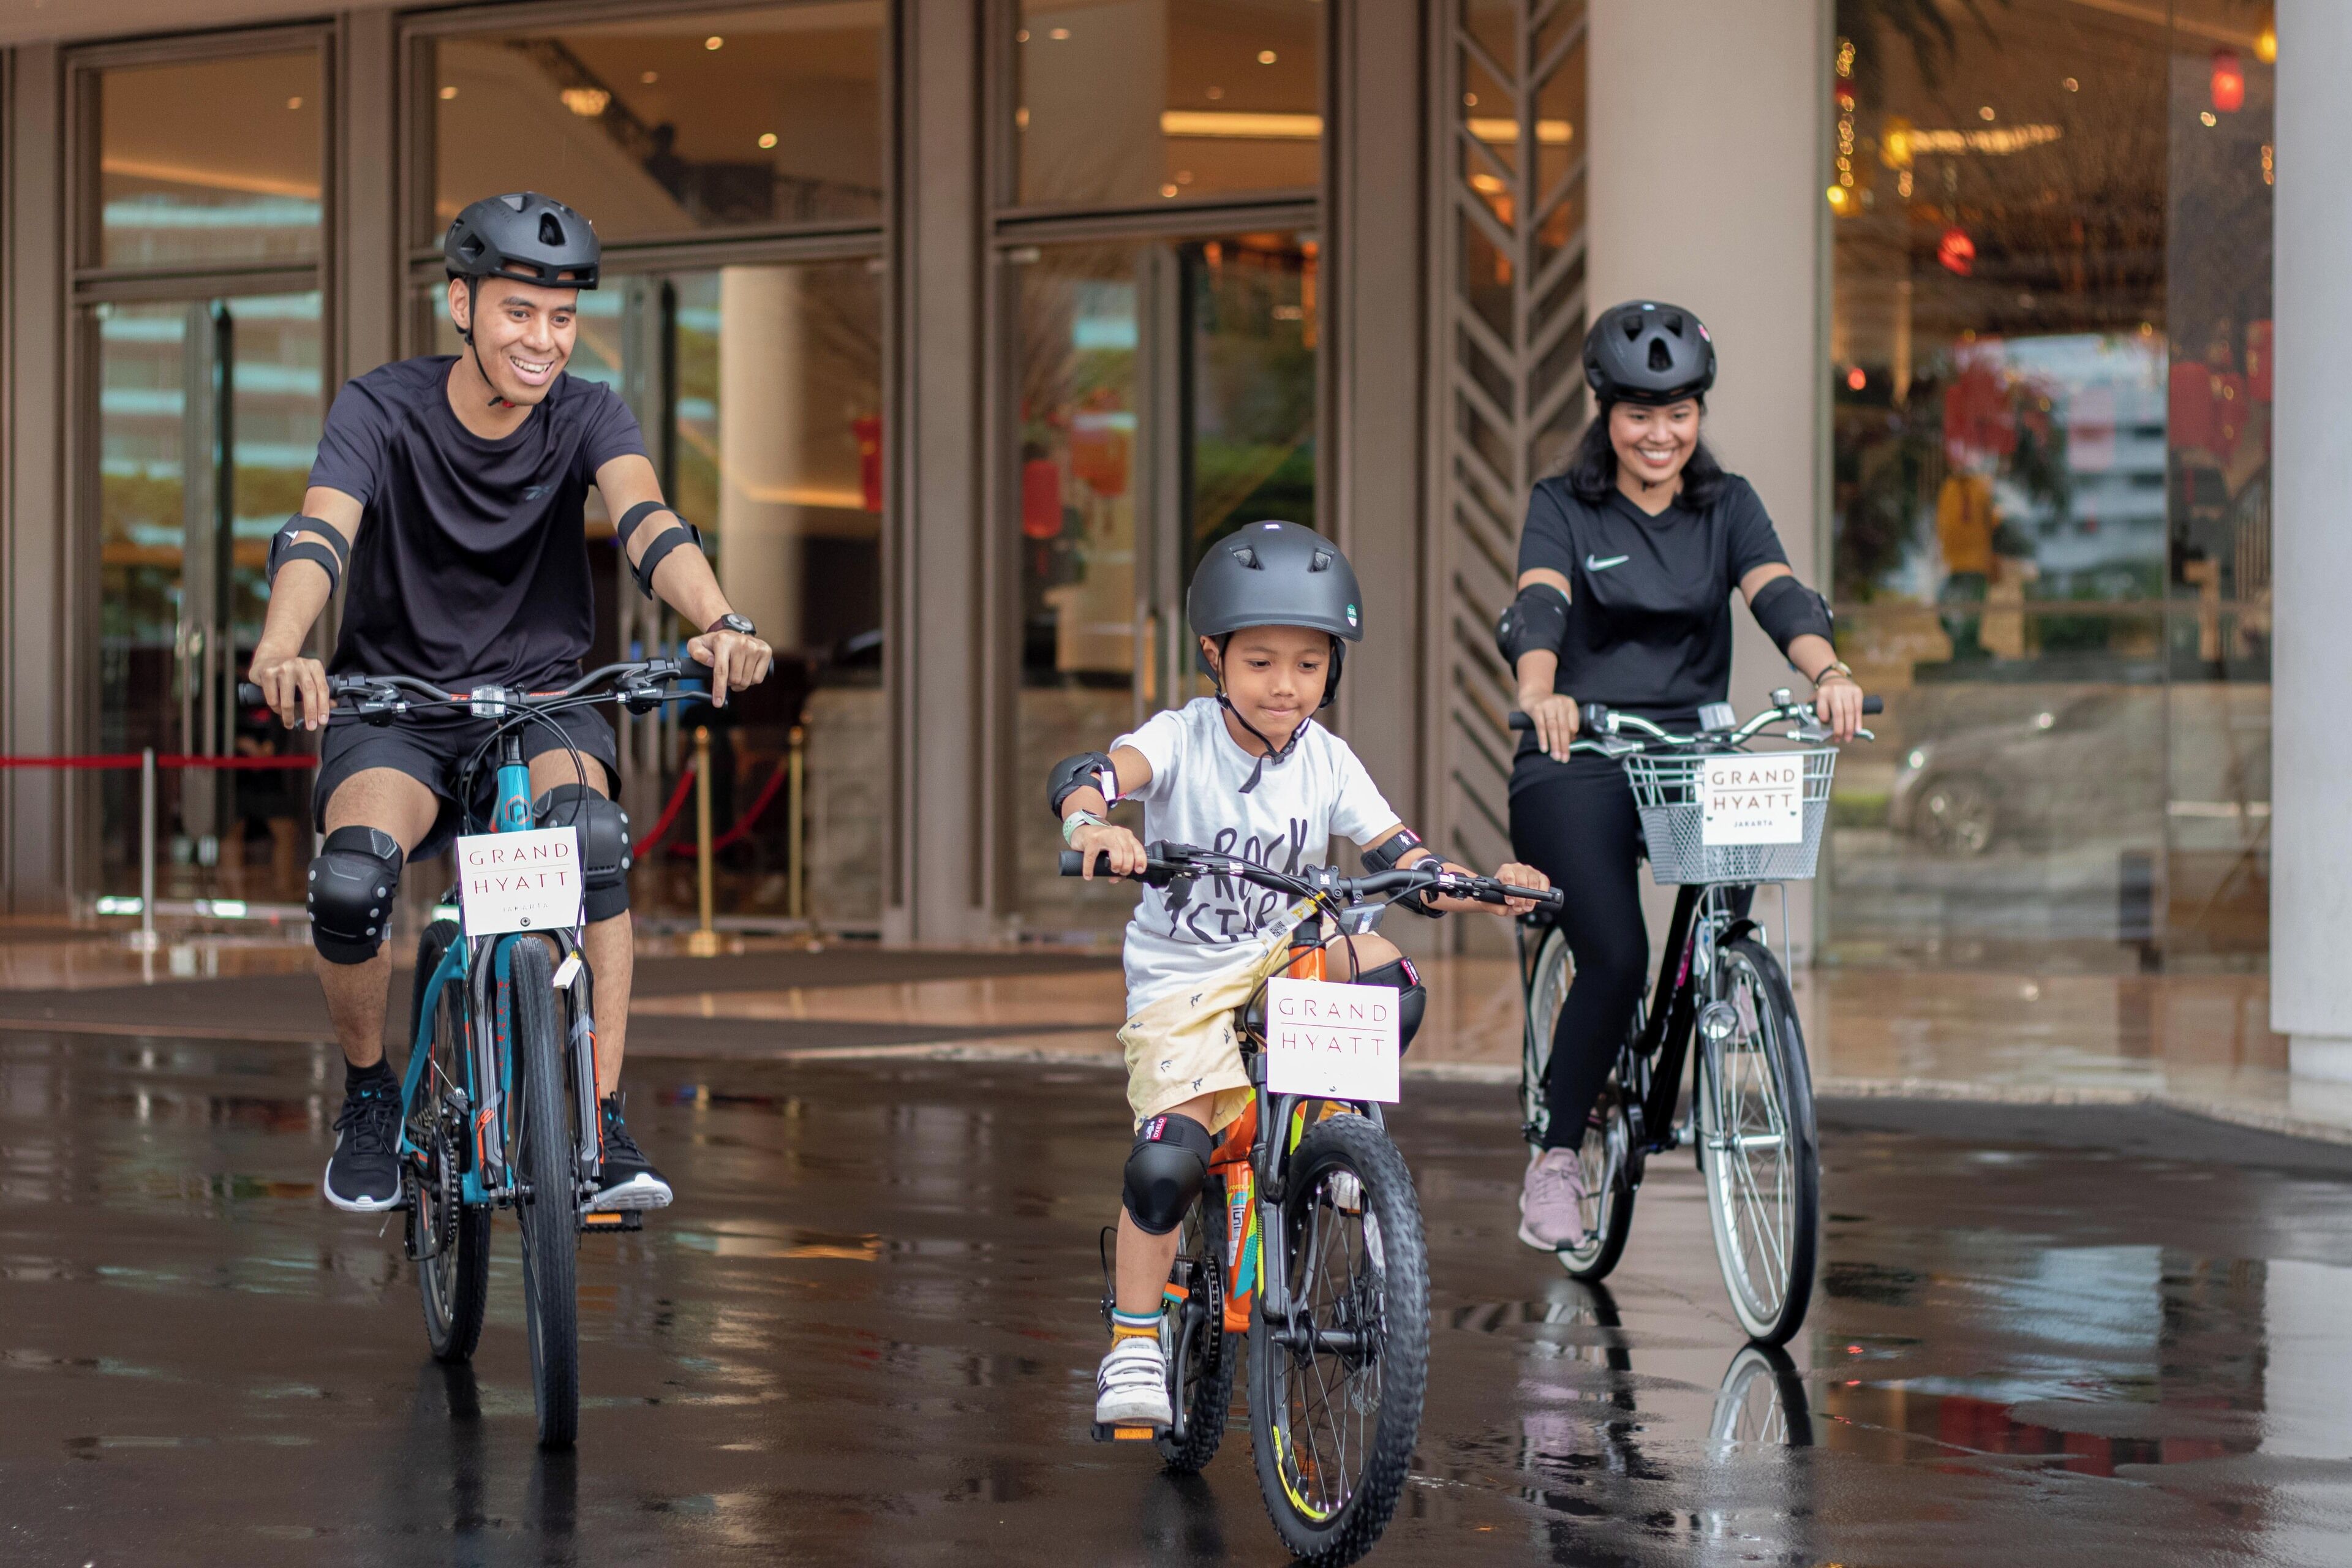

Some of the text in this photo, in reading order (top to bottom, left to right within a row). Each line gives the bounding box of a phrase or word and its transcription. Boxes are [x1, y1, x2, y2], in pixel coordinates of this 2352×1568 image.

[1711, 769, 1795, 786] GRAND
[1713, 794, 1792, 810] HYATT
[469, 843, 568, 865] GRAND
[474, 871, 568, 894] HYATT
[1279, 998, 1387, 1022] GRAND
[1282, 1032, 1384, 1056] HYATT
[1153, 1118, 1164, 1137] OXELO
